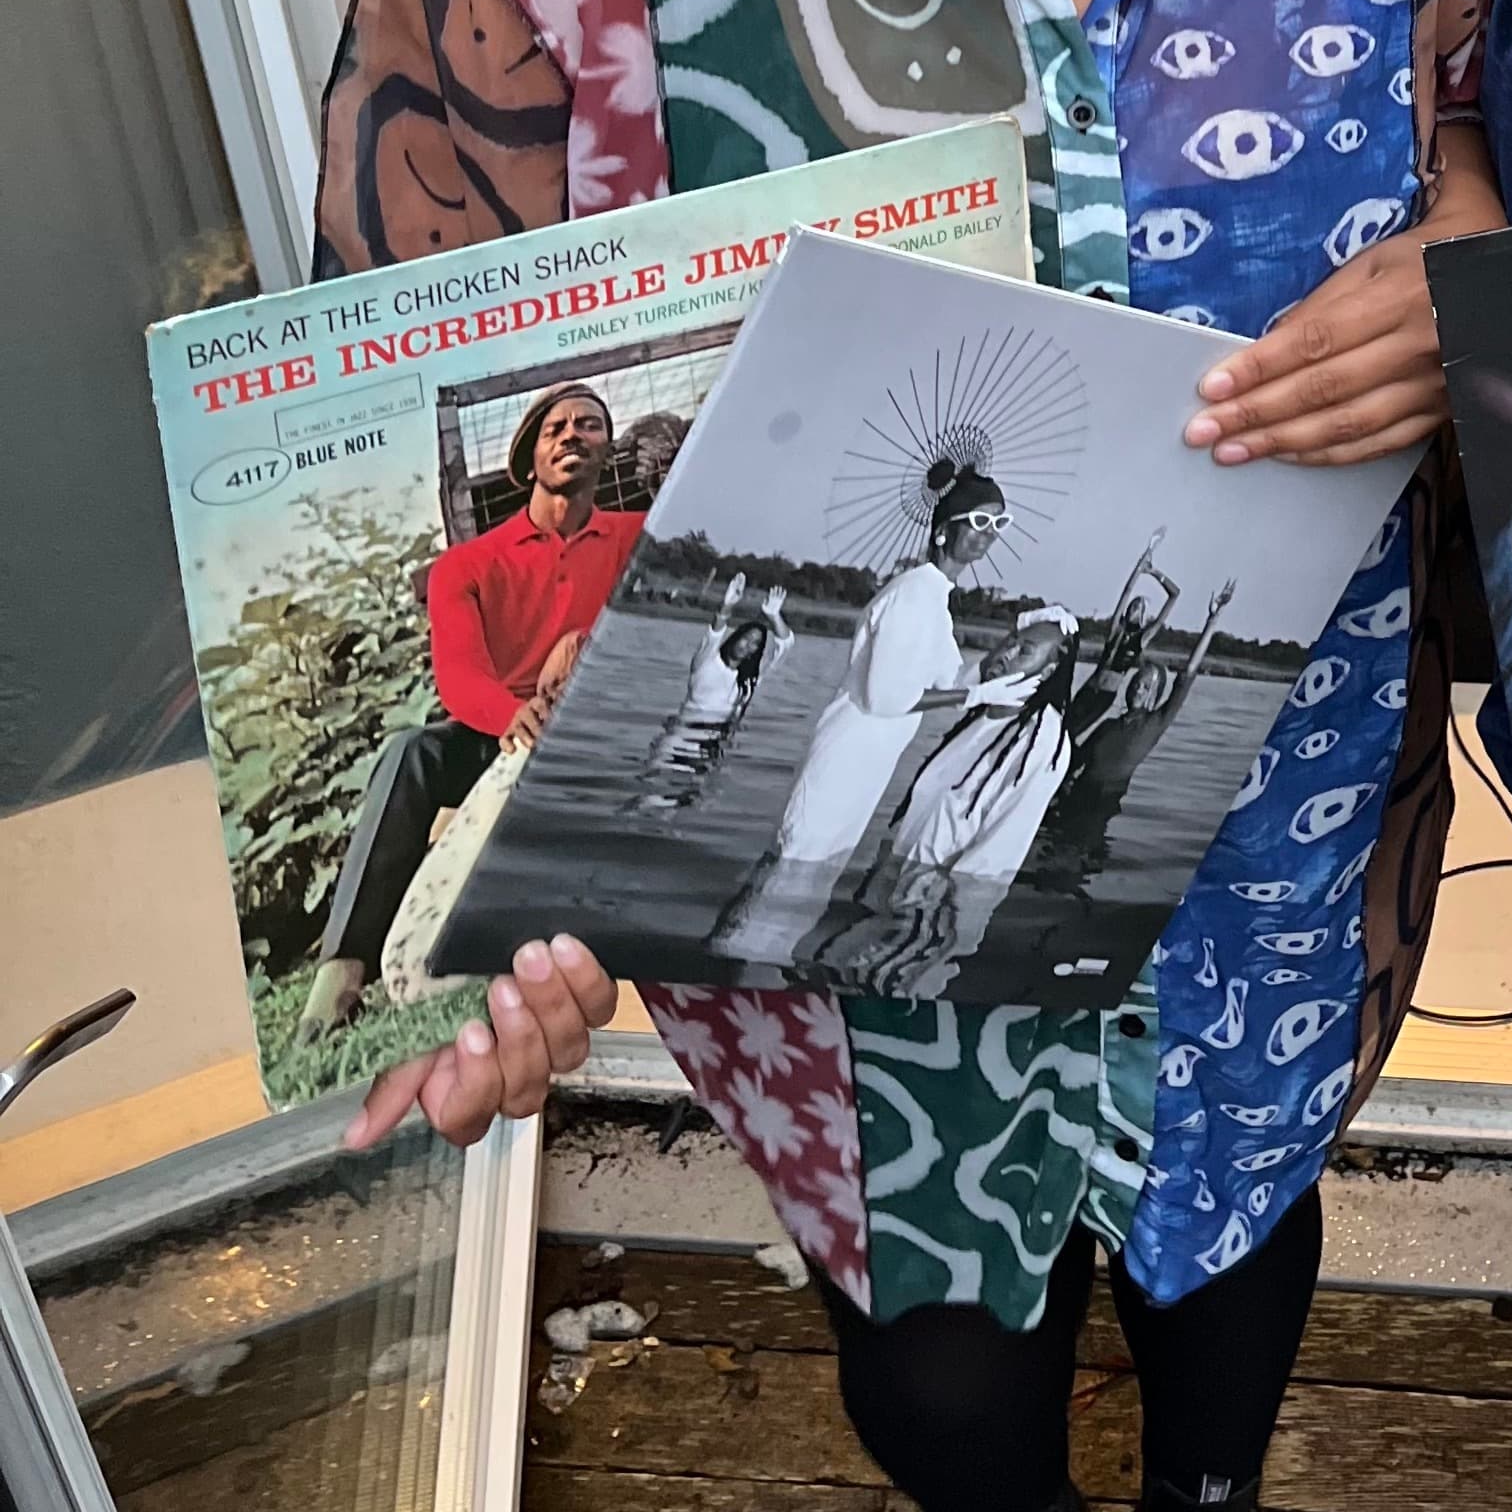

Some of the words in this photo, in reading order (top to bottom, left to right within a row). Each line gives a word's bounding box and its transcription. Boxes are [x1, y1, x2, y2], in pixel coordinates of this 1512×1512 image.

[186, 332, 269, 370] BACK
[281, 314, 311, 346] AT
[321, 298, 382, 334] THE
[393, 263, 521, 317] CHICKEN
[535, 236, 628, 282] SHACK
[193, 355, 317, 414] THE
[337, 263, 665, 378] INCREDIBLE
[854, 178, 999, 239] SMITH
[557, 316, 629, 348] STANLEY
[888, 230, 947, 253] ONALD
[954, 215, 1002, 241] BAILEY
[225, 461, 279, 488] 4117
[296, 443, 338, 469] BLUE
[344, 429, 387, 455] NOTE
